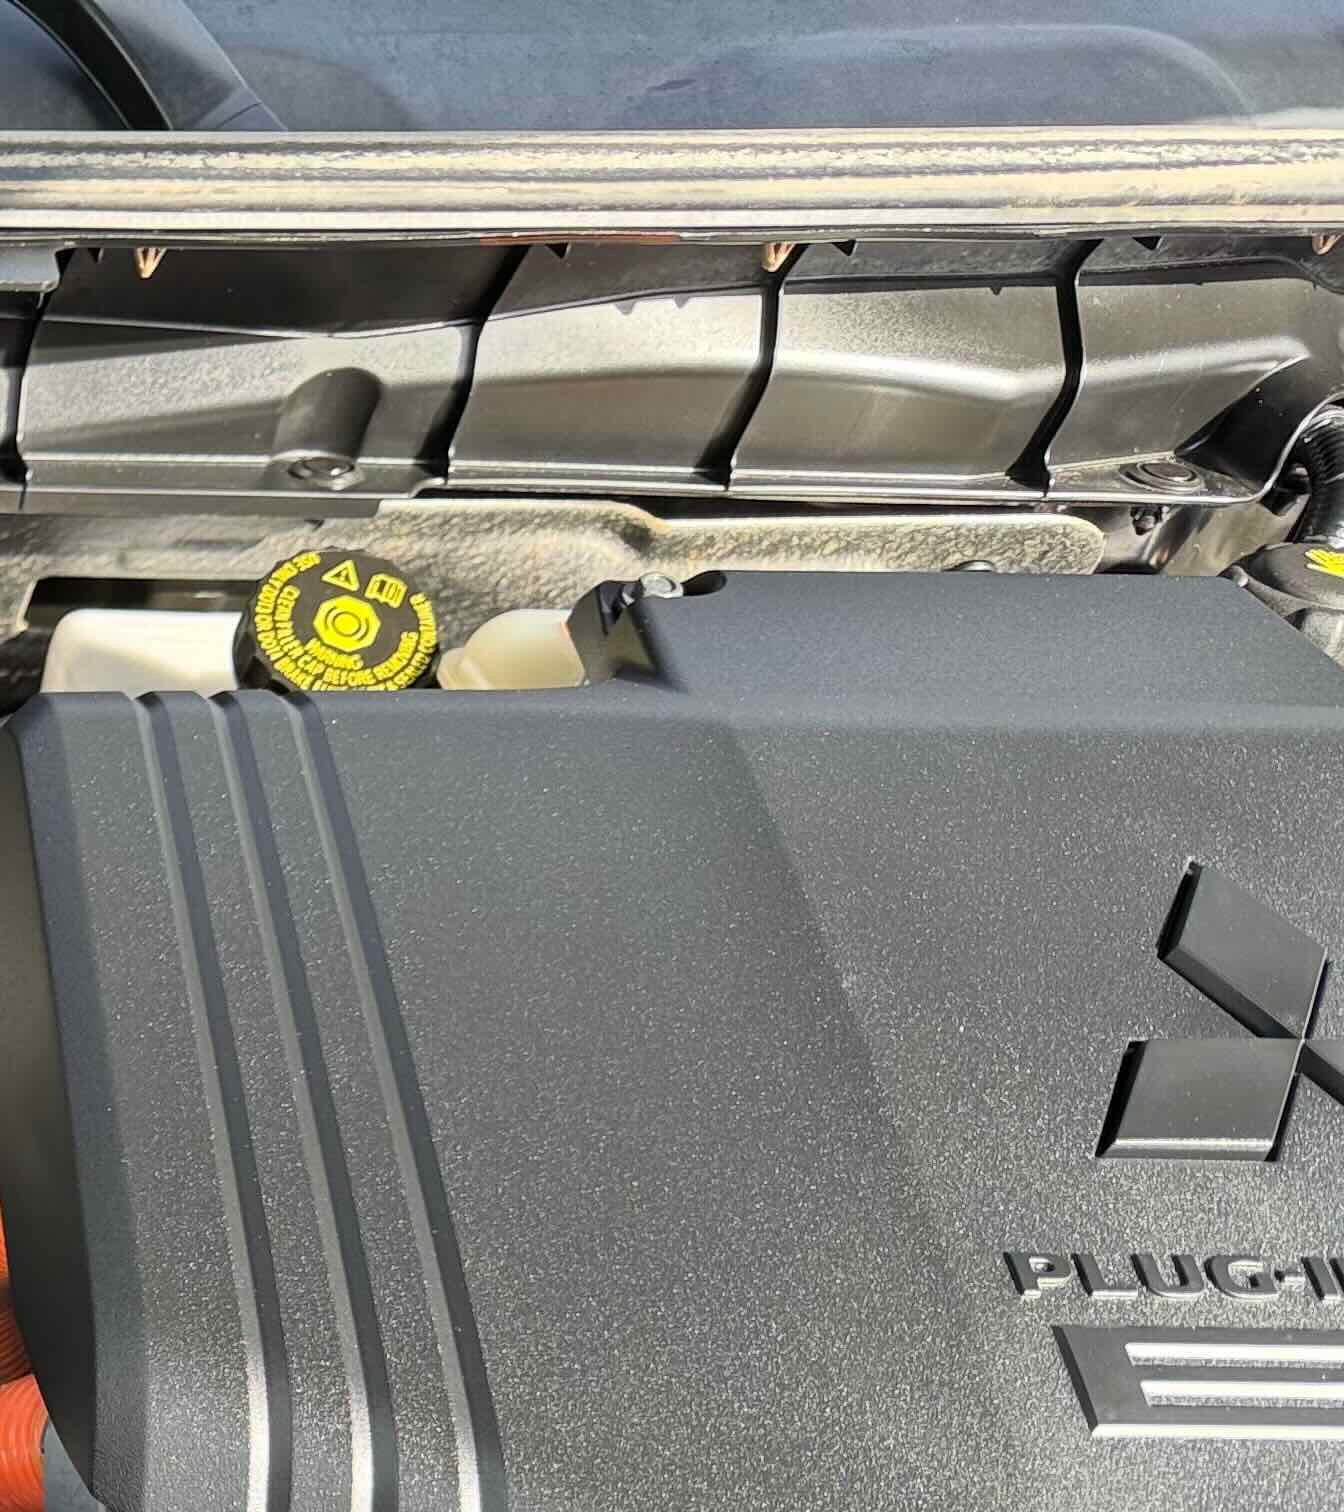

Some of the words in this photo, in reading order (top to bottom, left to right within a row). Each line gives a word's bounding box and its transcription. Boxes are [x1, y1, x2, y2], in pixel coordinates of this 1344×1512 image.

[255, 614, 273, 631] OR
[293, 653, 326, 678] CAP
[321, 667, 376, 687] BEFORE
[1003, 1251, 1344, 1301] PLUG-I
